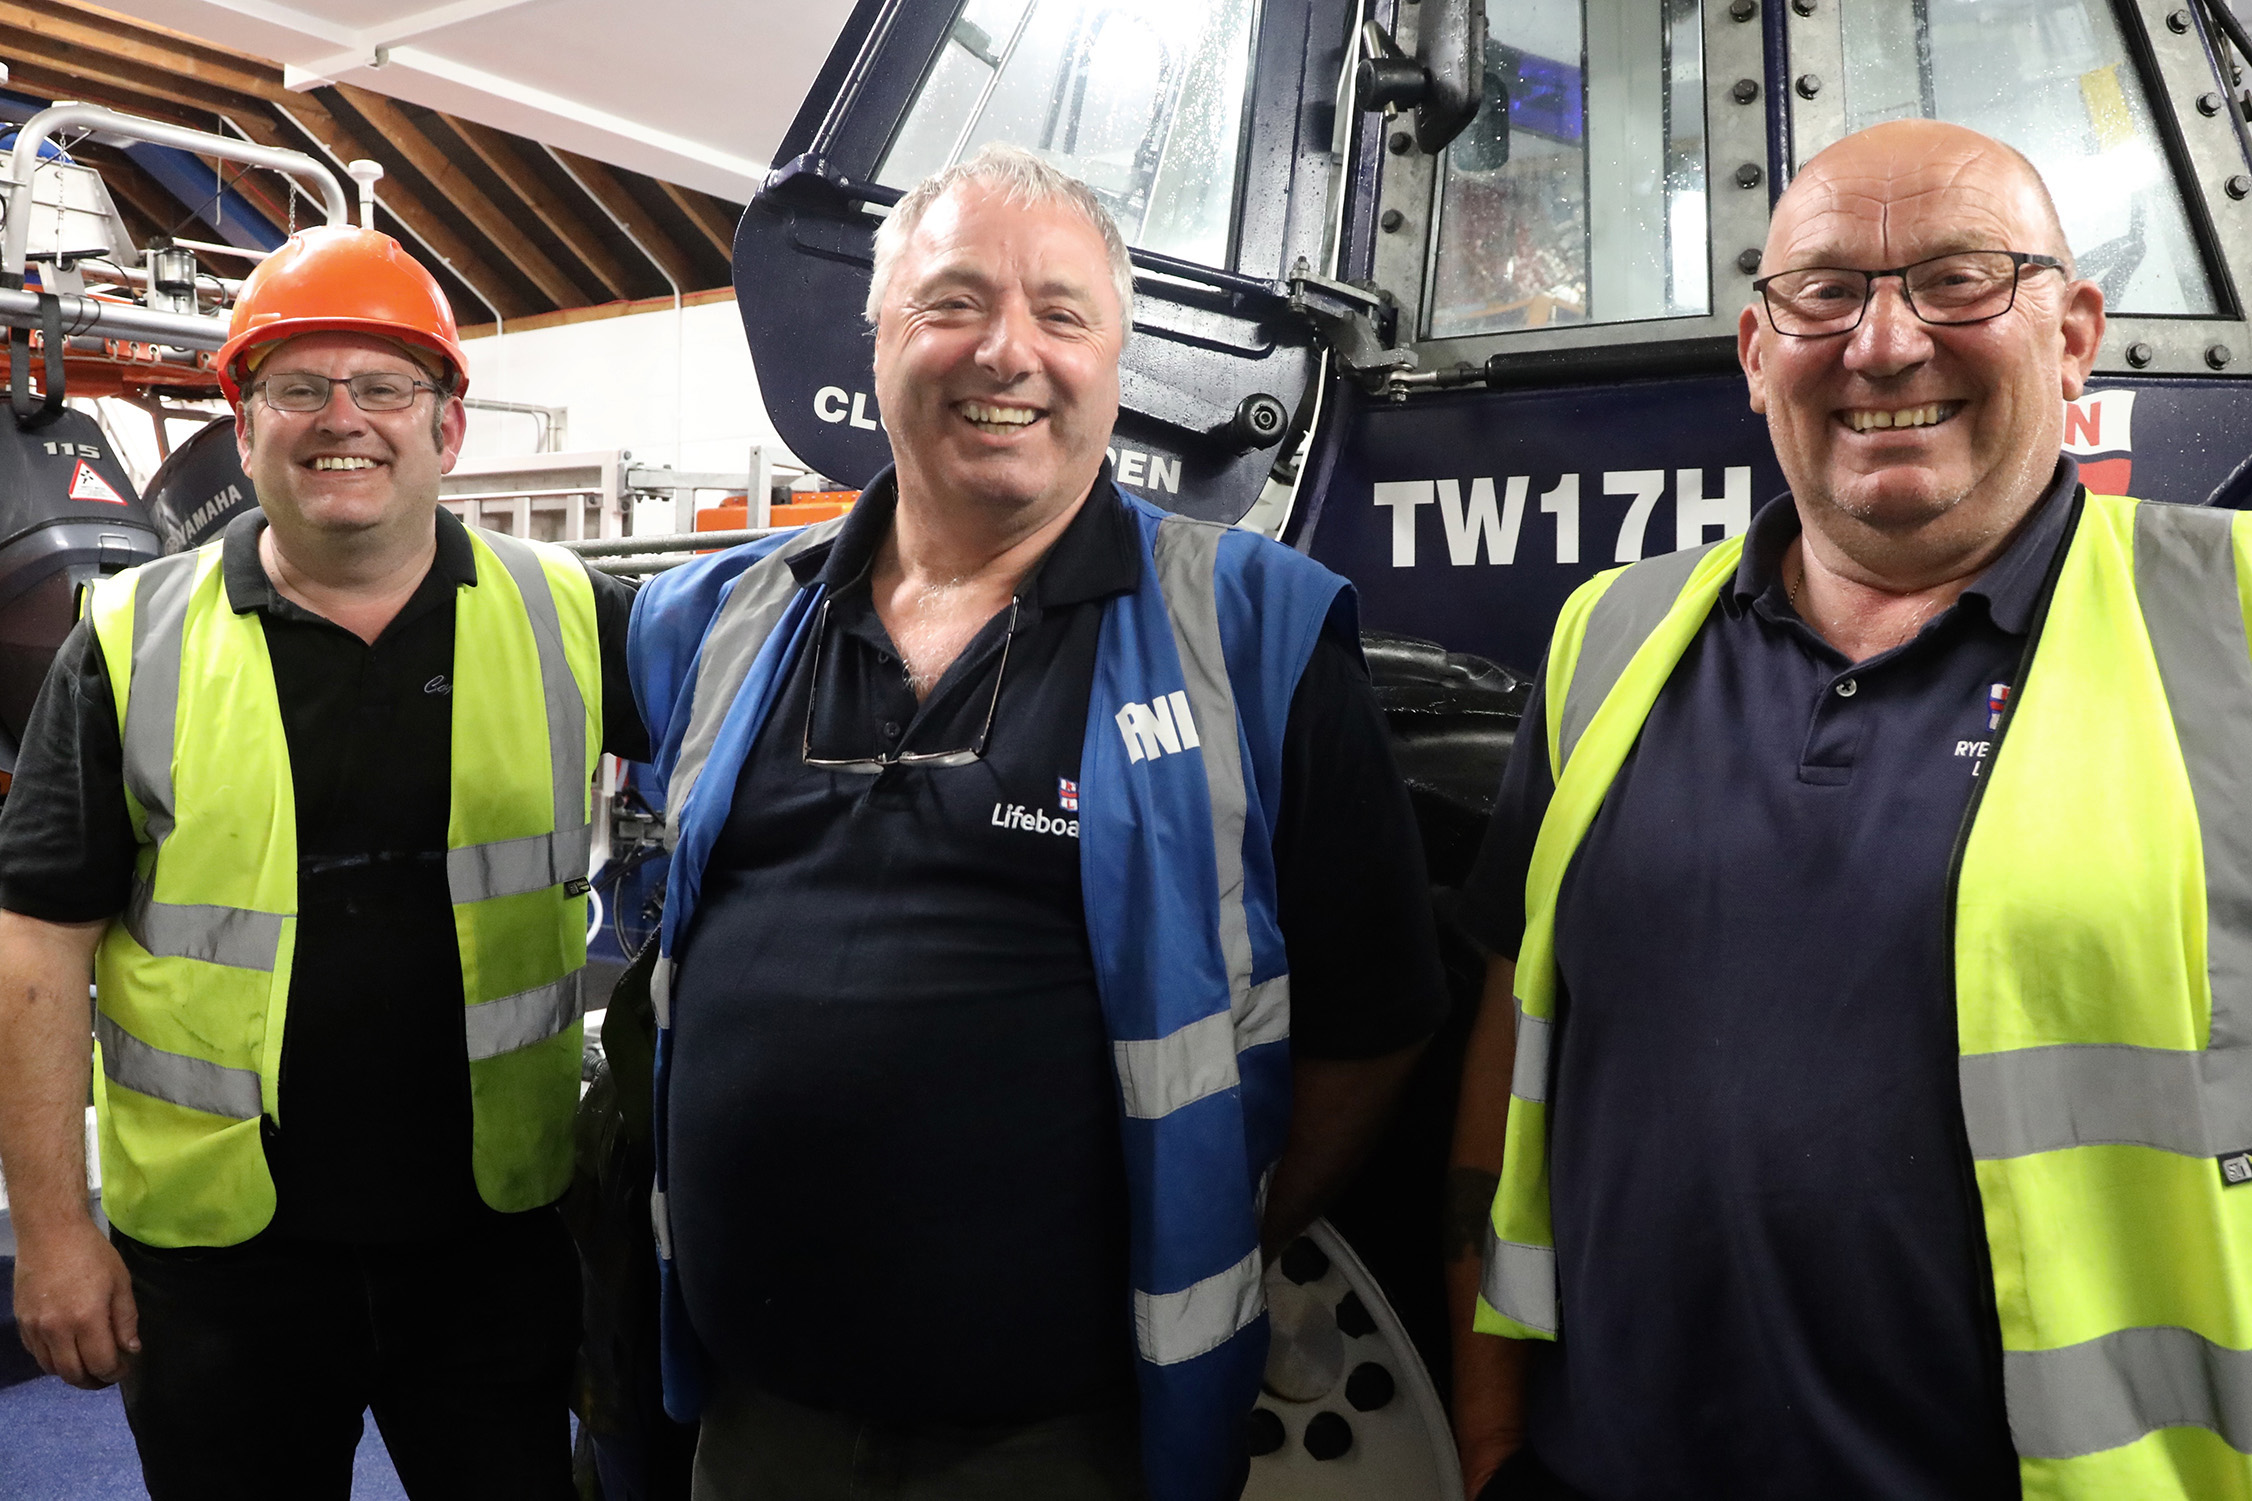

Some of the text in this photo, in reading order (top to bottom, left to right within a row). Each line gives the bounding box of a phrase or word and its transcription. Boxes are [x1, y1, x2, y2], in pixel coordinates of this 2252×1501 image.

[813, 386, 888, 431] CL
[43, 441, 102, 459] 115
[175, 484, 243, 546] YAMAHA
[1373, 466, 1752, 567] TW17H
[1954, 741, 1990, 757] RYE
